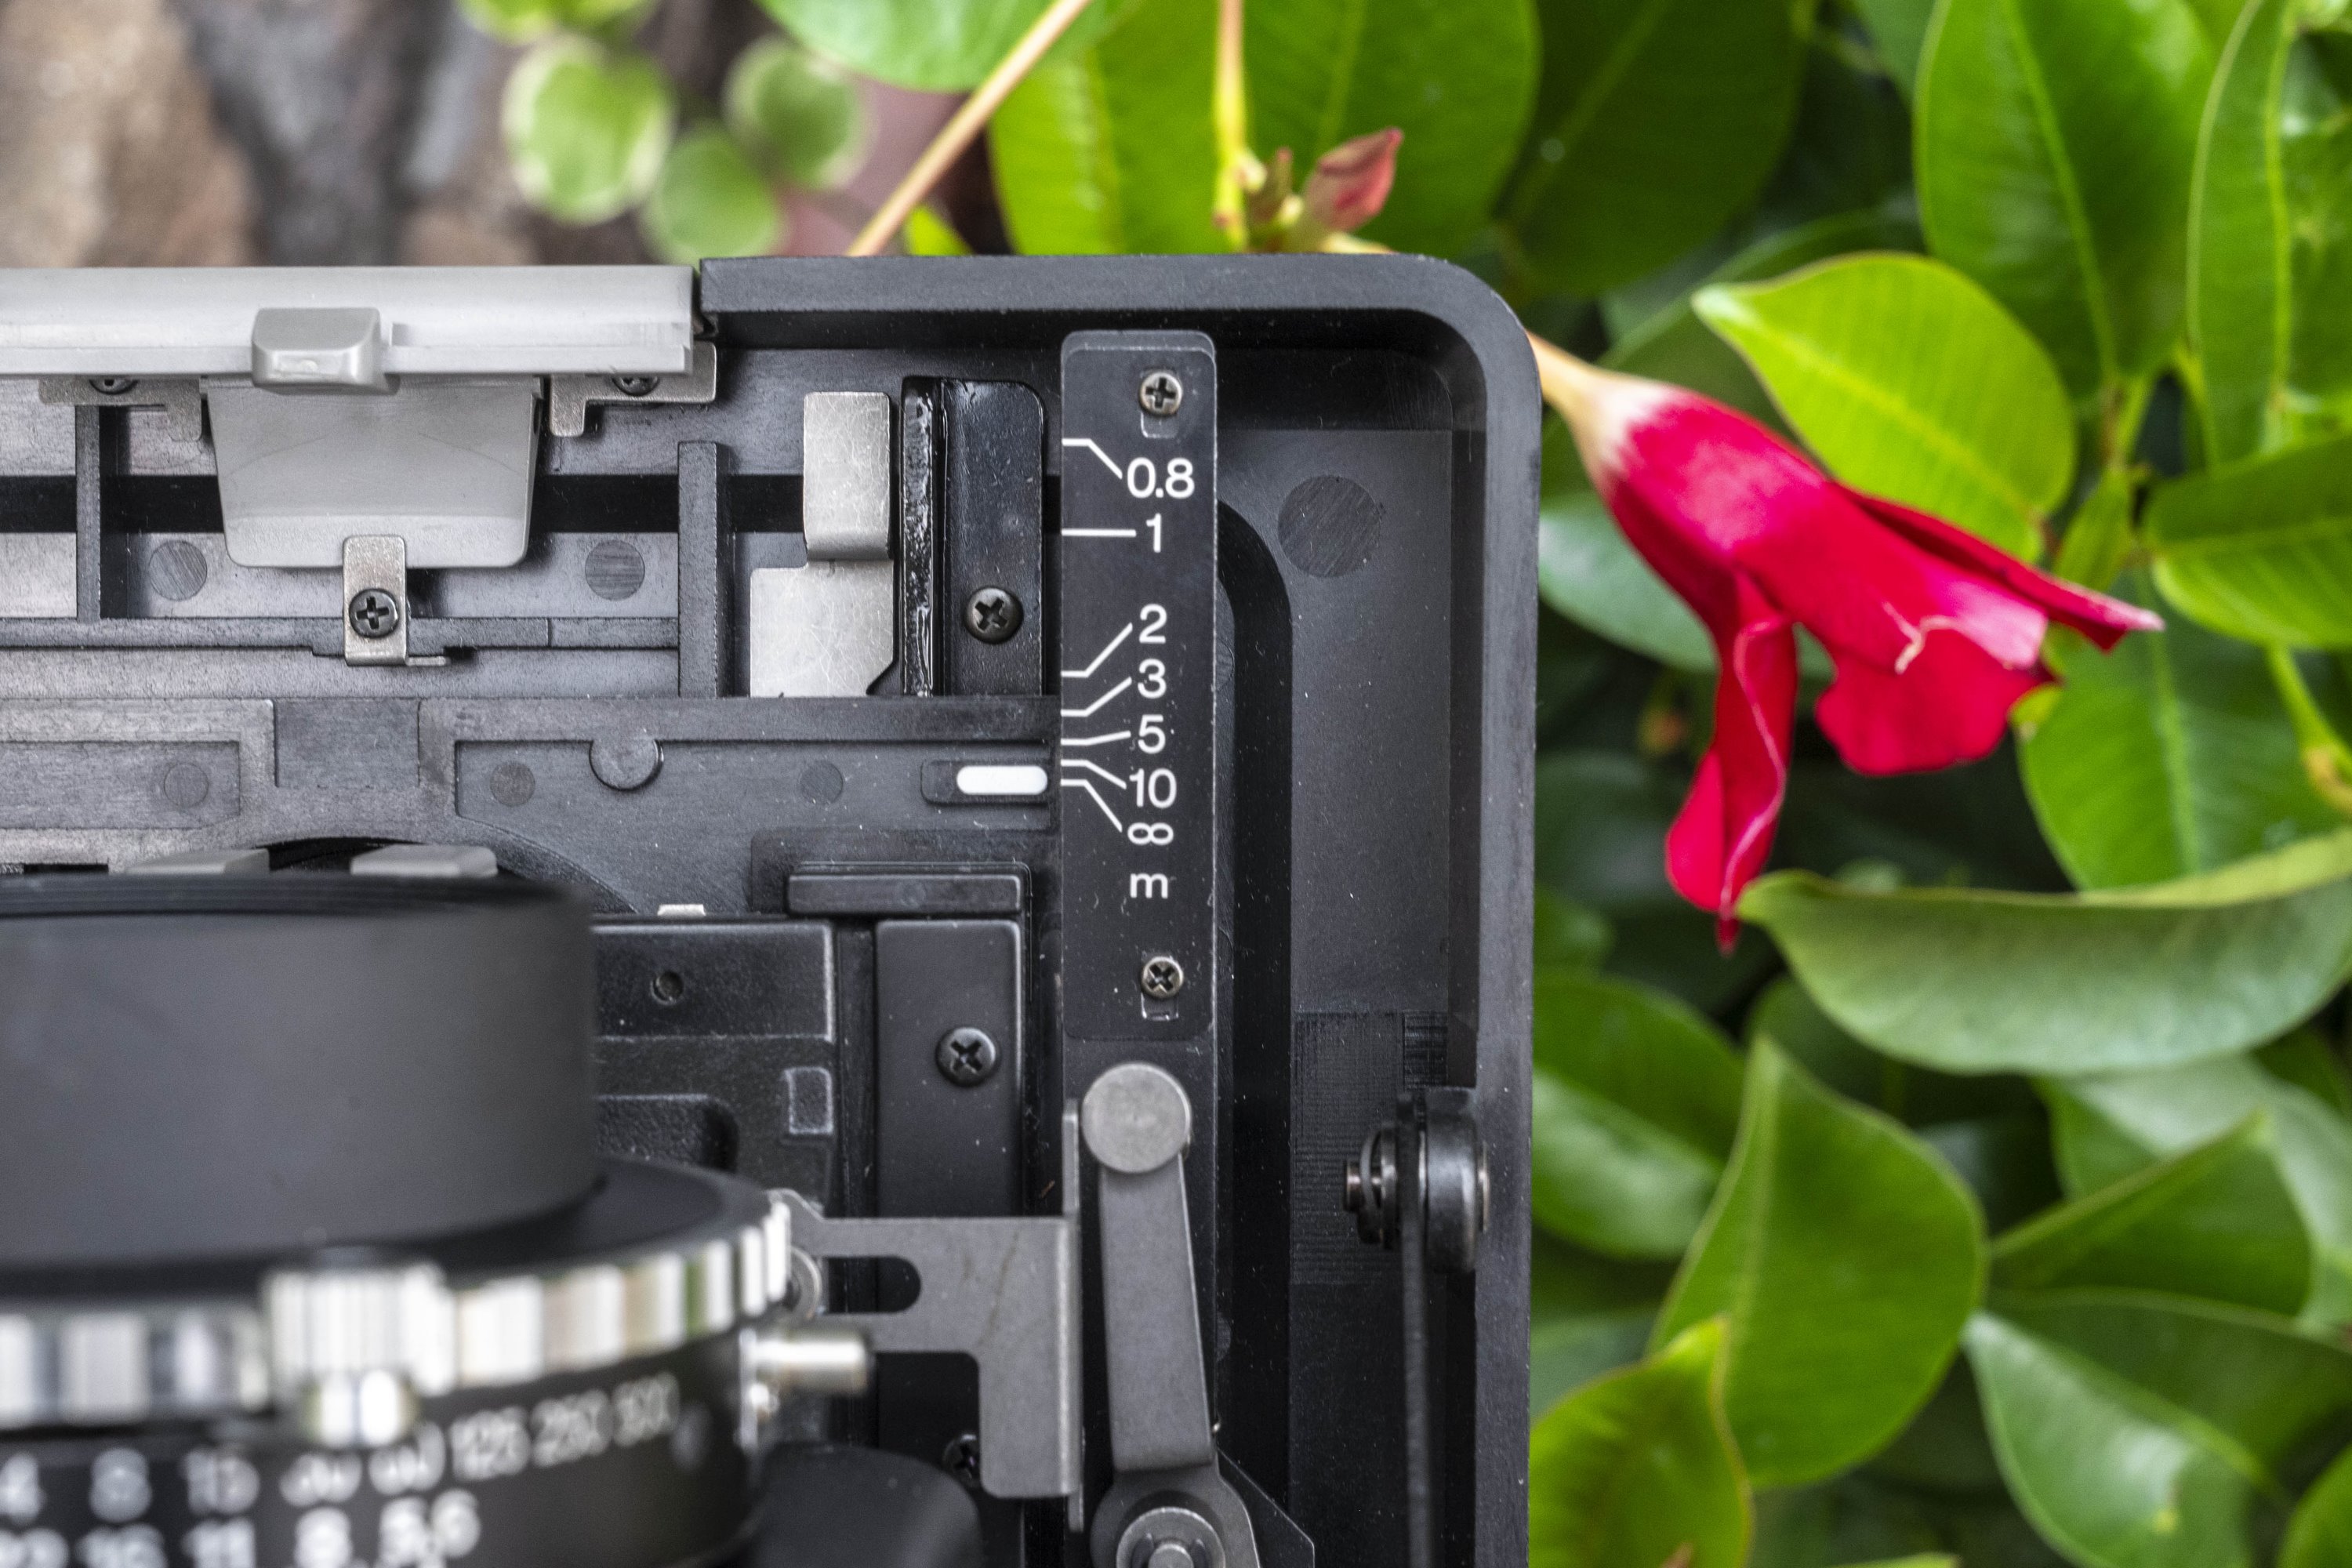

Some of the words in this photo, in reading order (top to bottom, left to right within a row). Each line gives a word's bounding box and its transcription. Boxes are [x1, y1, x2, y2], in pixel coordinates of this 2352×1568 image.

[1127, 457, 1196, 499] 0.8
[1145, 513, 1162, 554] 1
[1139, 603, 1167, 644] 2
[1137, 658, 1167, 699] 3
[1137, 714, 1166, 754] 5
[1129, 768, 1177, 809] 10
[1130, 873, 1169, 899] m
